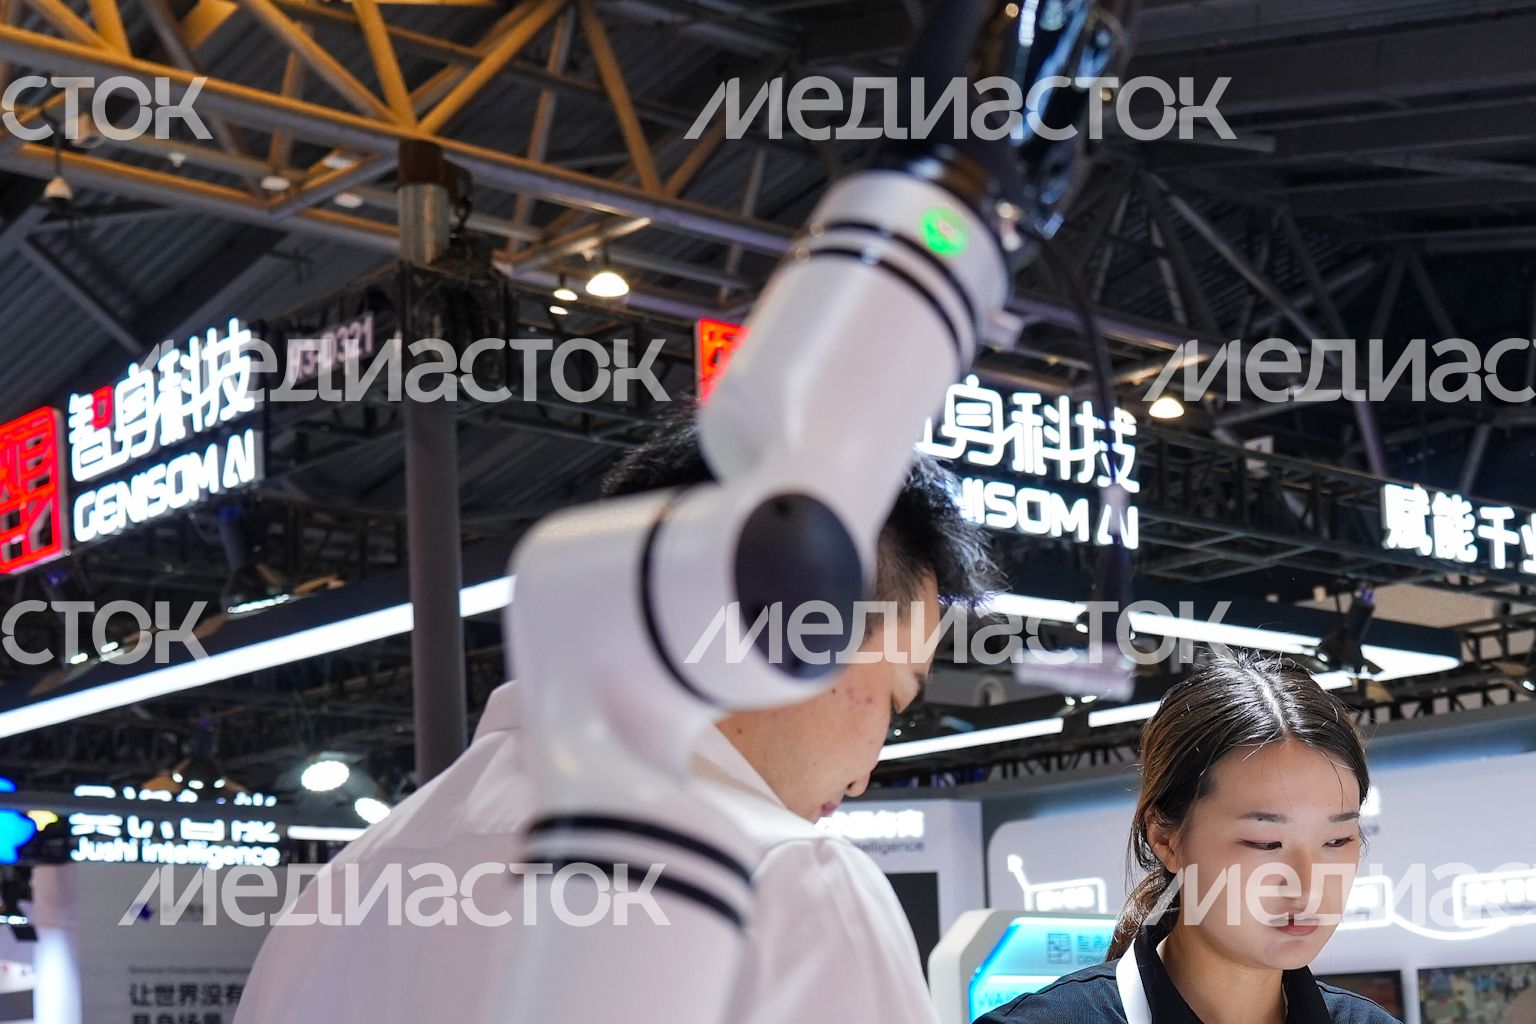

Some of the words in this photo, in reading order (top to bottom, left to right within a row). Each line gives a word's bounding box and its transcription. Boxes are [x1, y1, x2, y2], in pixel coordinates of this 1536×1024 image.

[69, 317, 255, 482] 智身科技
[914, 374, 1140, 493] 身科技
[960, 477, 1090, 543] ISOM
